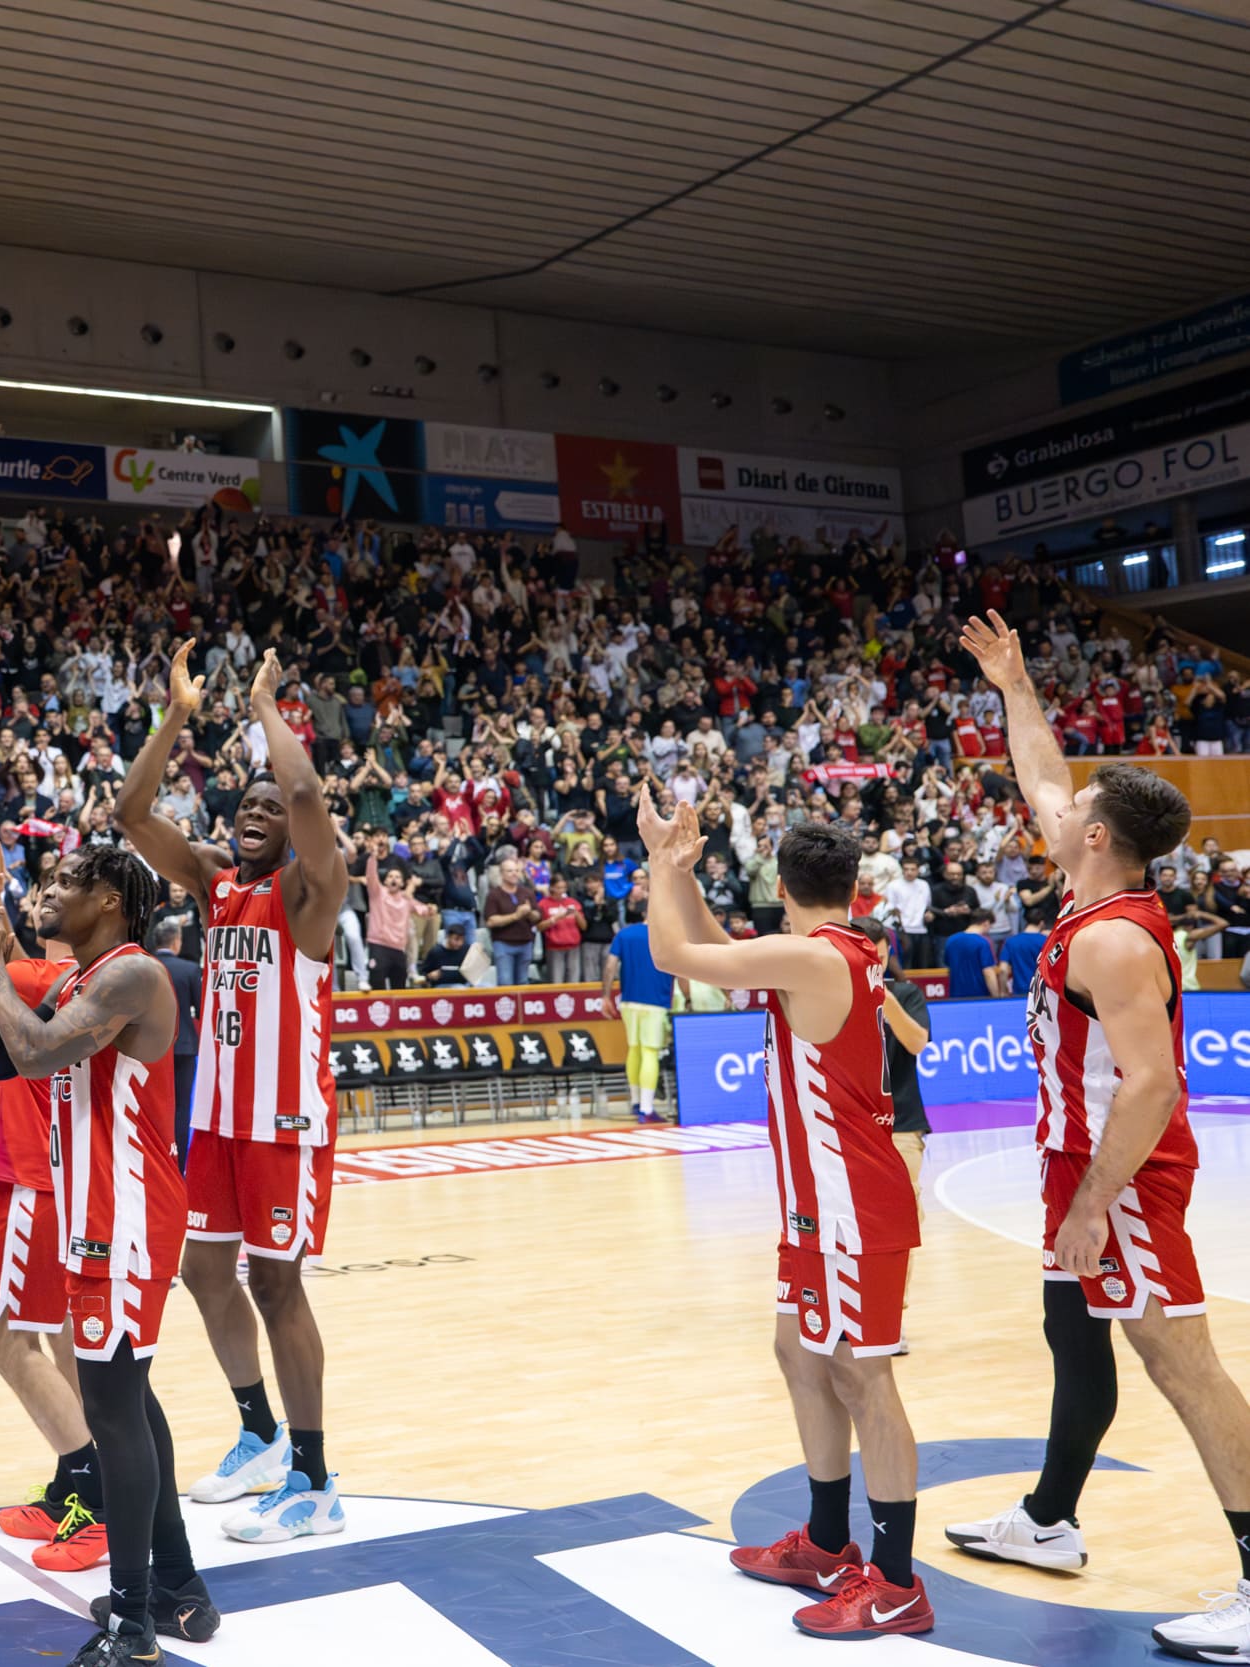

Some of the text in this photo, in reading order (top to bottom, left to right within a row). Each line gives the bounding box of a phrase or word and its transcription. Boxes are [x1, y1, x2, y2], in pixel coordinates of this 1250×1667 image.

[1014, 426, 1116, 467] Grabalosa
[158, 467, 241, 487] Centre Verd
[737, 467, 890, 500] Diari de Girona
[580, 499, 663, 522] ESTRELLA
[926, 984, 945, 998] BG
[335, 1008, 358, 1023] BG
[399, 1006, 422, 1021] BG
[464, 1003, 486, 1018] BG
[524, 1001, 546, 1015] BG
[216, 1009, 242, 1047] 46
